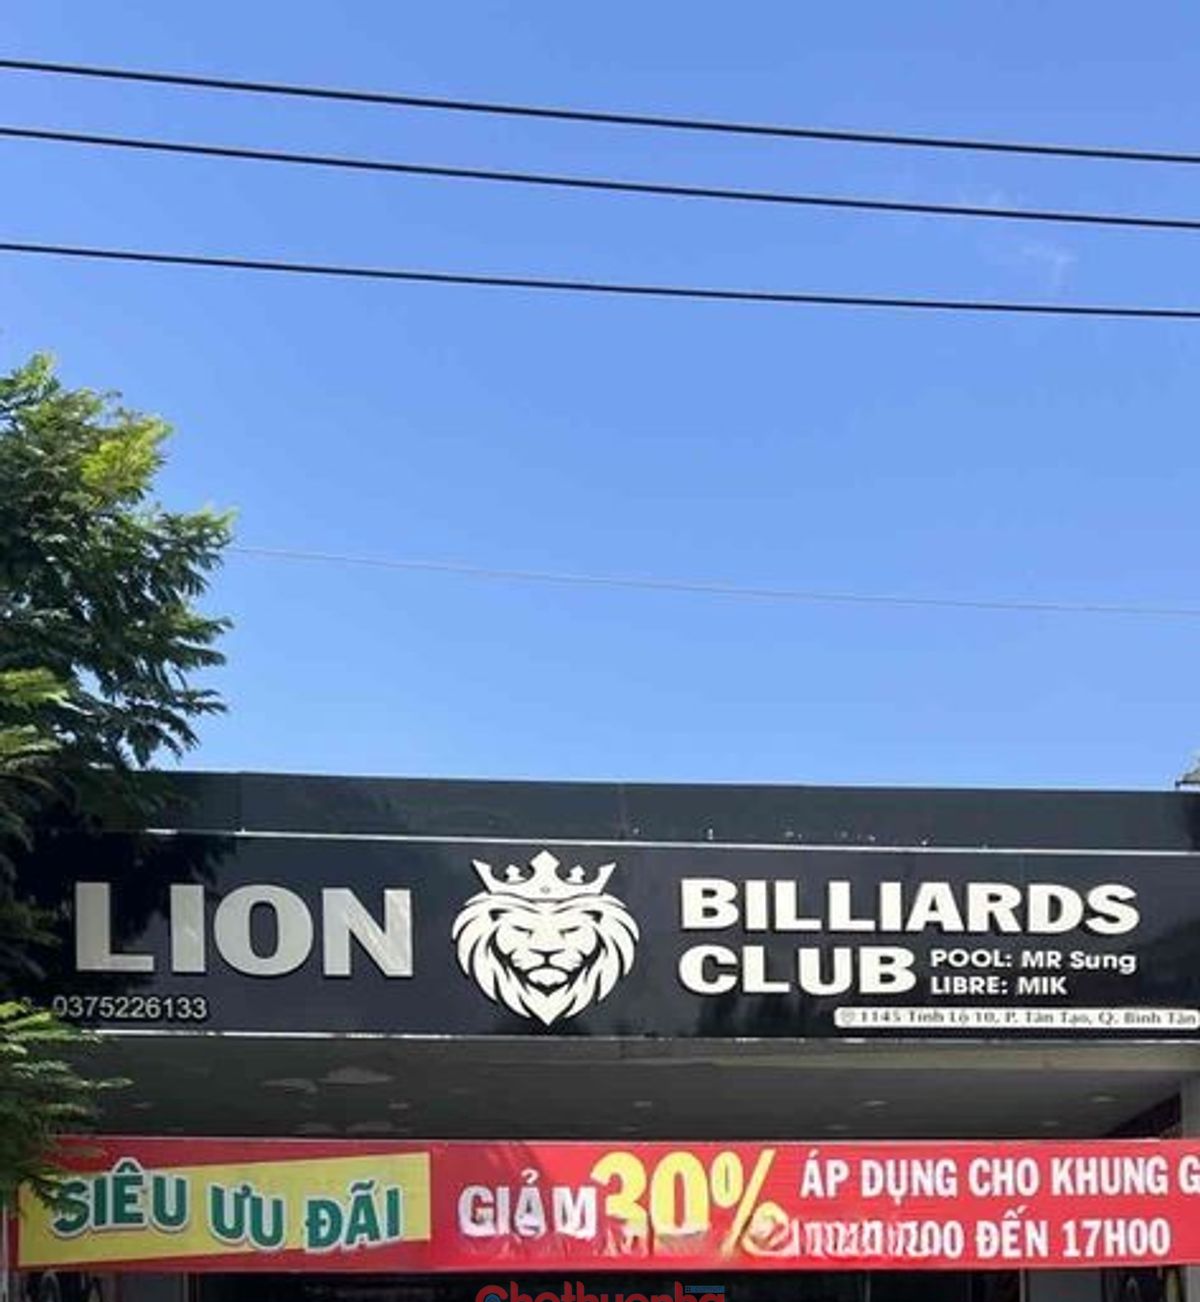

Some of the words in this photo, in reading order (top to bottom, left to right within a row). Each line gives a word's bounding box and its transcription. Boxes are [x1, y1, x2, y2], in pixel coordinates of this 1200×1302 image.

[75, 881, 414, 978] LION
[680, 878, 1141, 935] BILLIARDS
[678, 944, 917, 995] CLUB
[930, 949, 1012, 968] POOL:
[1022, 951, 1062, 968] MR
[1070, 951, 1137, 974] Sung
[930, 976, 1009, 995] LIBRE:
[1017, 976, 1068, 995] MIK
[53, 996, 208, 1019] 0375226133
[1005, 1011, 1018, 1024] P.
[457, 1167, 597, 1240] GIẢM
[590, 1148, 790, 1258] 30%
[800, 1148, 850, 1198] ÁP
[860, 1158, 958, 1206] DỤNG
[968, 1157, 1040, 1197] CHO
[1051, 1154, 1168, 1197] KHUNG
[52, 1158, 189, 1236] SIÊU
[209, 1181, 286, 1249] ƯU
[304, 1178, 402, 1252] ĐÃI
[975, 1204, 1050, 1259] ĐẾN
[1062, 1216, 1171, 1258] 17H00
